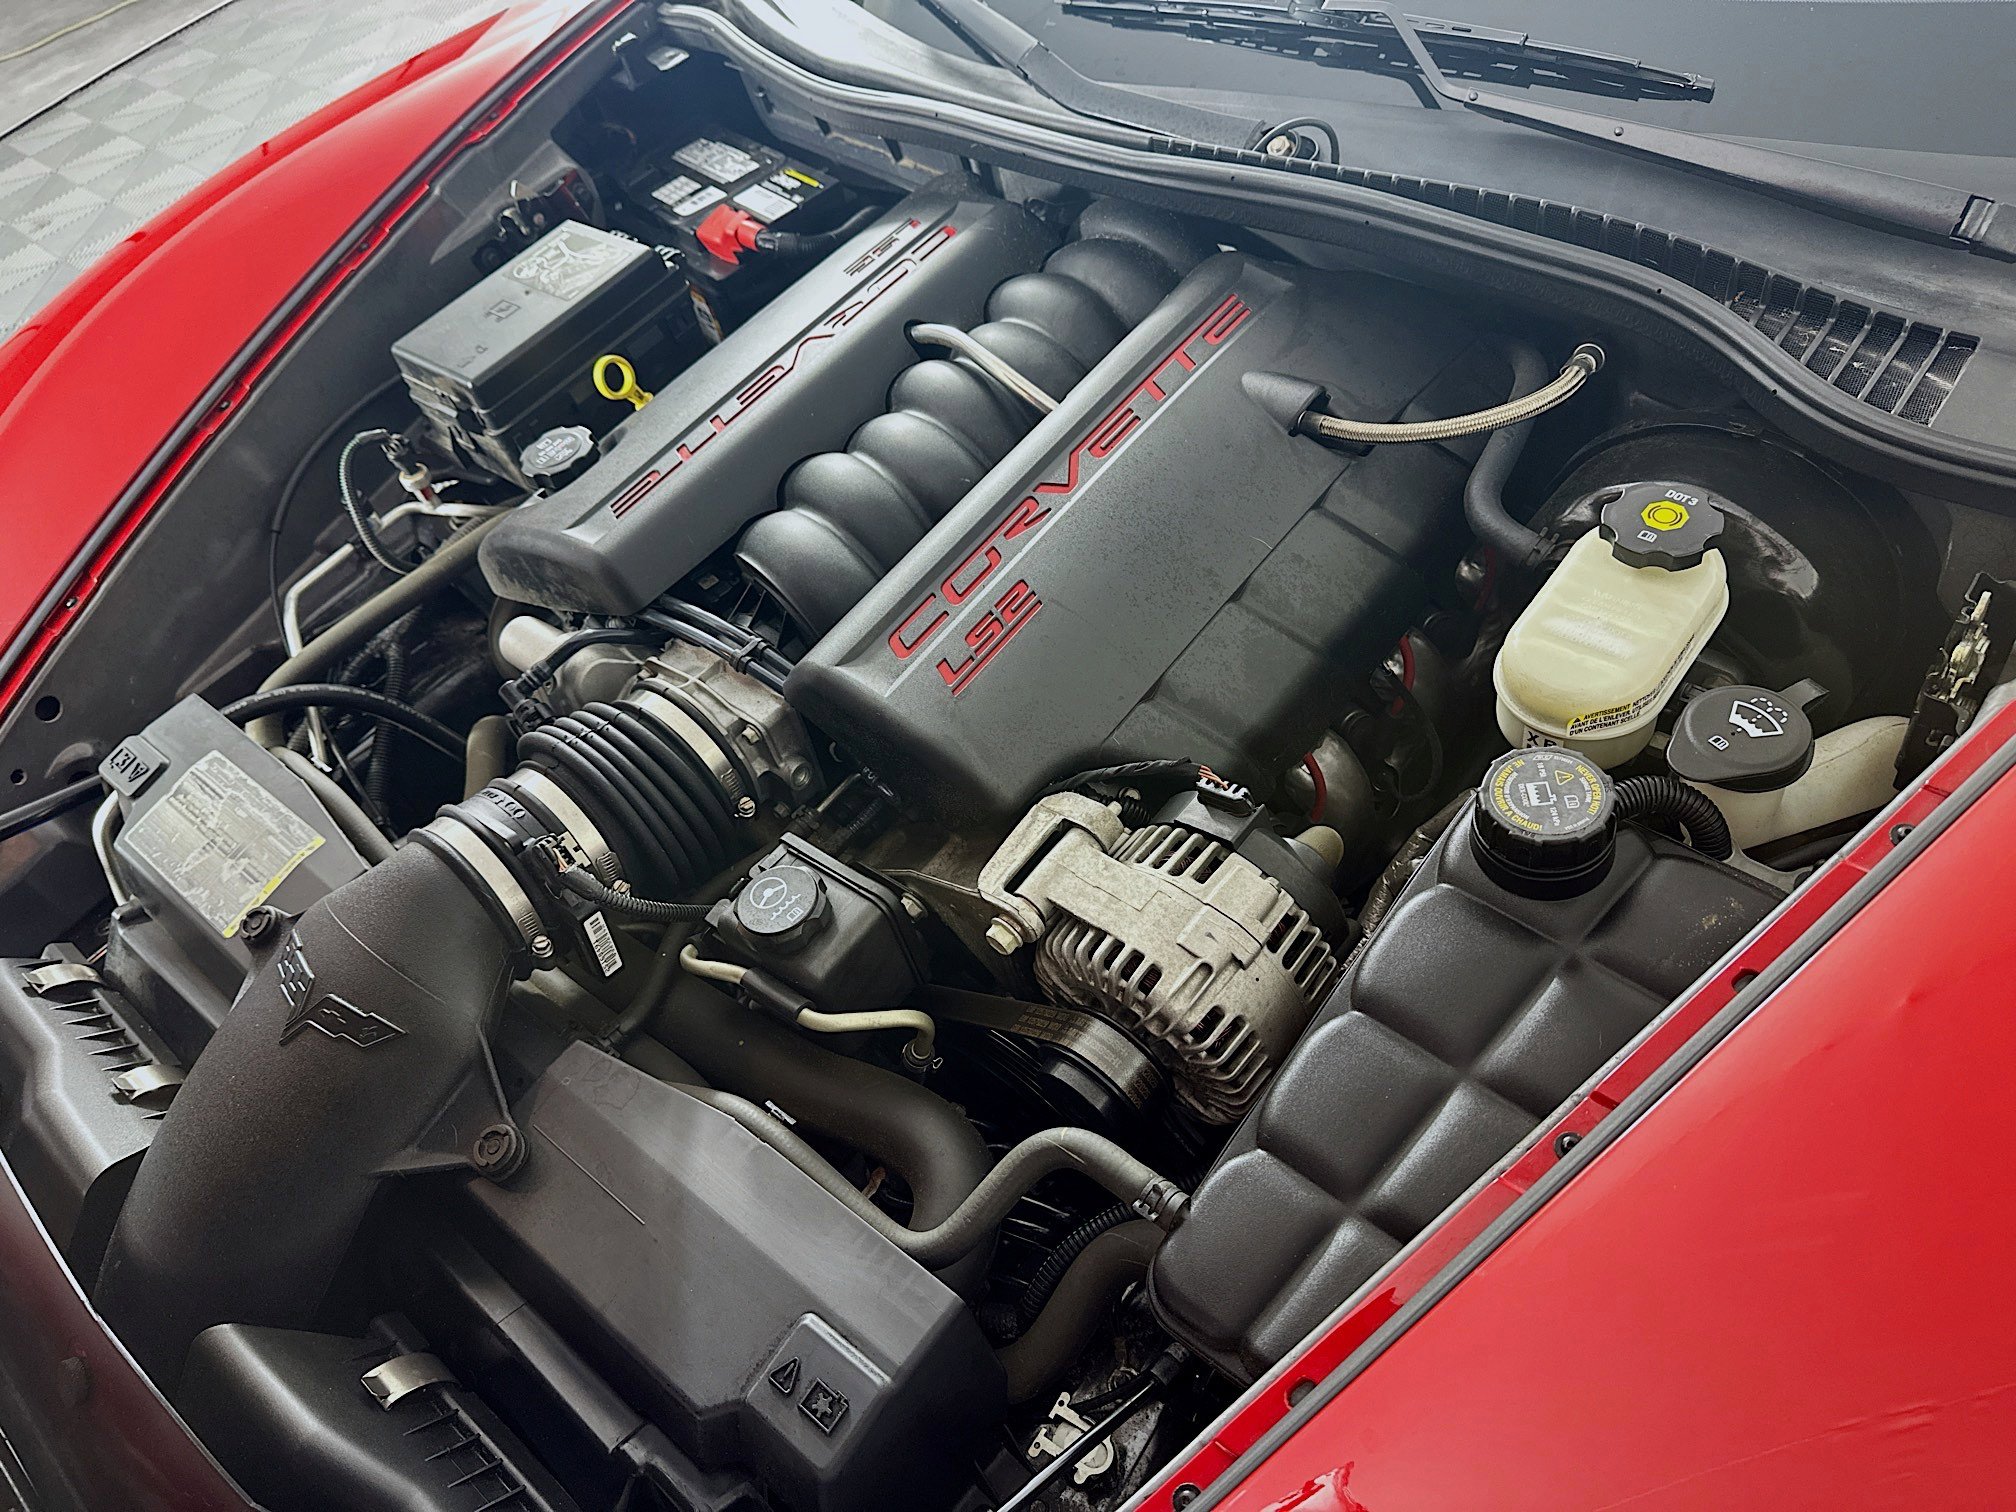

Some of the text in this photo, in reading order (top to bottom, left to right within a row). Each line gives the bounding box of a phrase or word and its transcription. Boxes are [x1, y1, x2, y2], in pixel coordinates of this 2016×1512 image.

[610, 225, 957, 519] CORVETTE
[888, 293, 1252, 660] CORVETTE
[1665, 489, 1699, 506] DOT 3
[935, 579, 1039, 687] LS2
[1583, 703, 1631, 720] AVERTISSEMENT
[1569, 728, 1583, 737] D'UN
[1583, 720, 1620, 732] CONTENANT
[1570, 719, 1589, 730] AVANT
[1589, 717, 1598, 725] DE
[1513, 758, 1525, 769] NE
[1494, 765, 1515, 788] JAMAIS
[1493, 787, 1507, 812] OUVRIR
[1575, 764, 1602, 816] NEVER OPEN HOT!
[1510, 813, 1544, 832] CHAUD!
